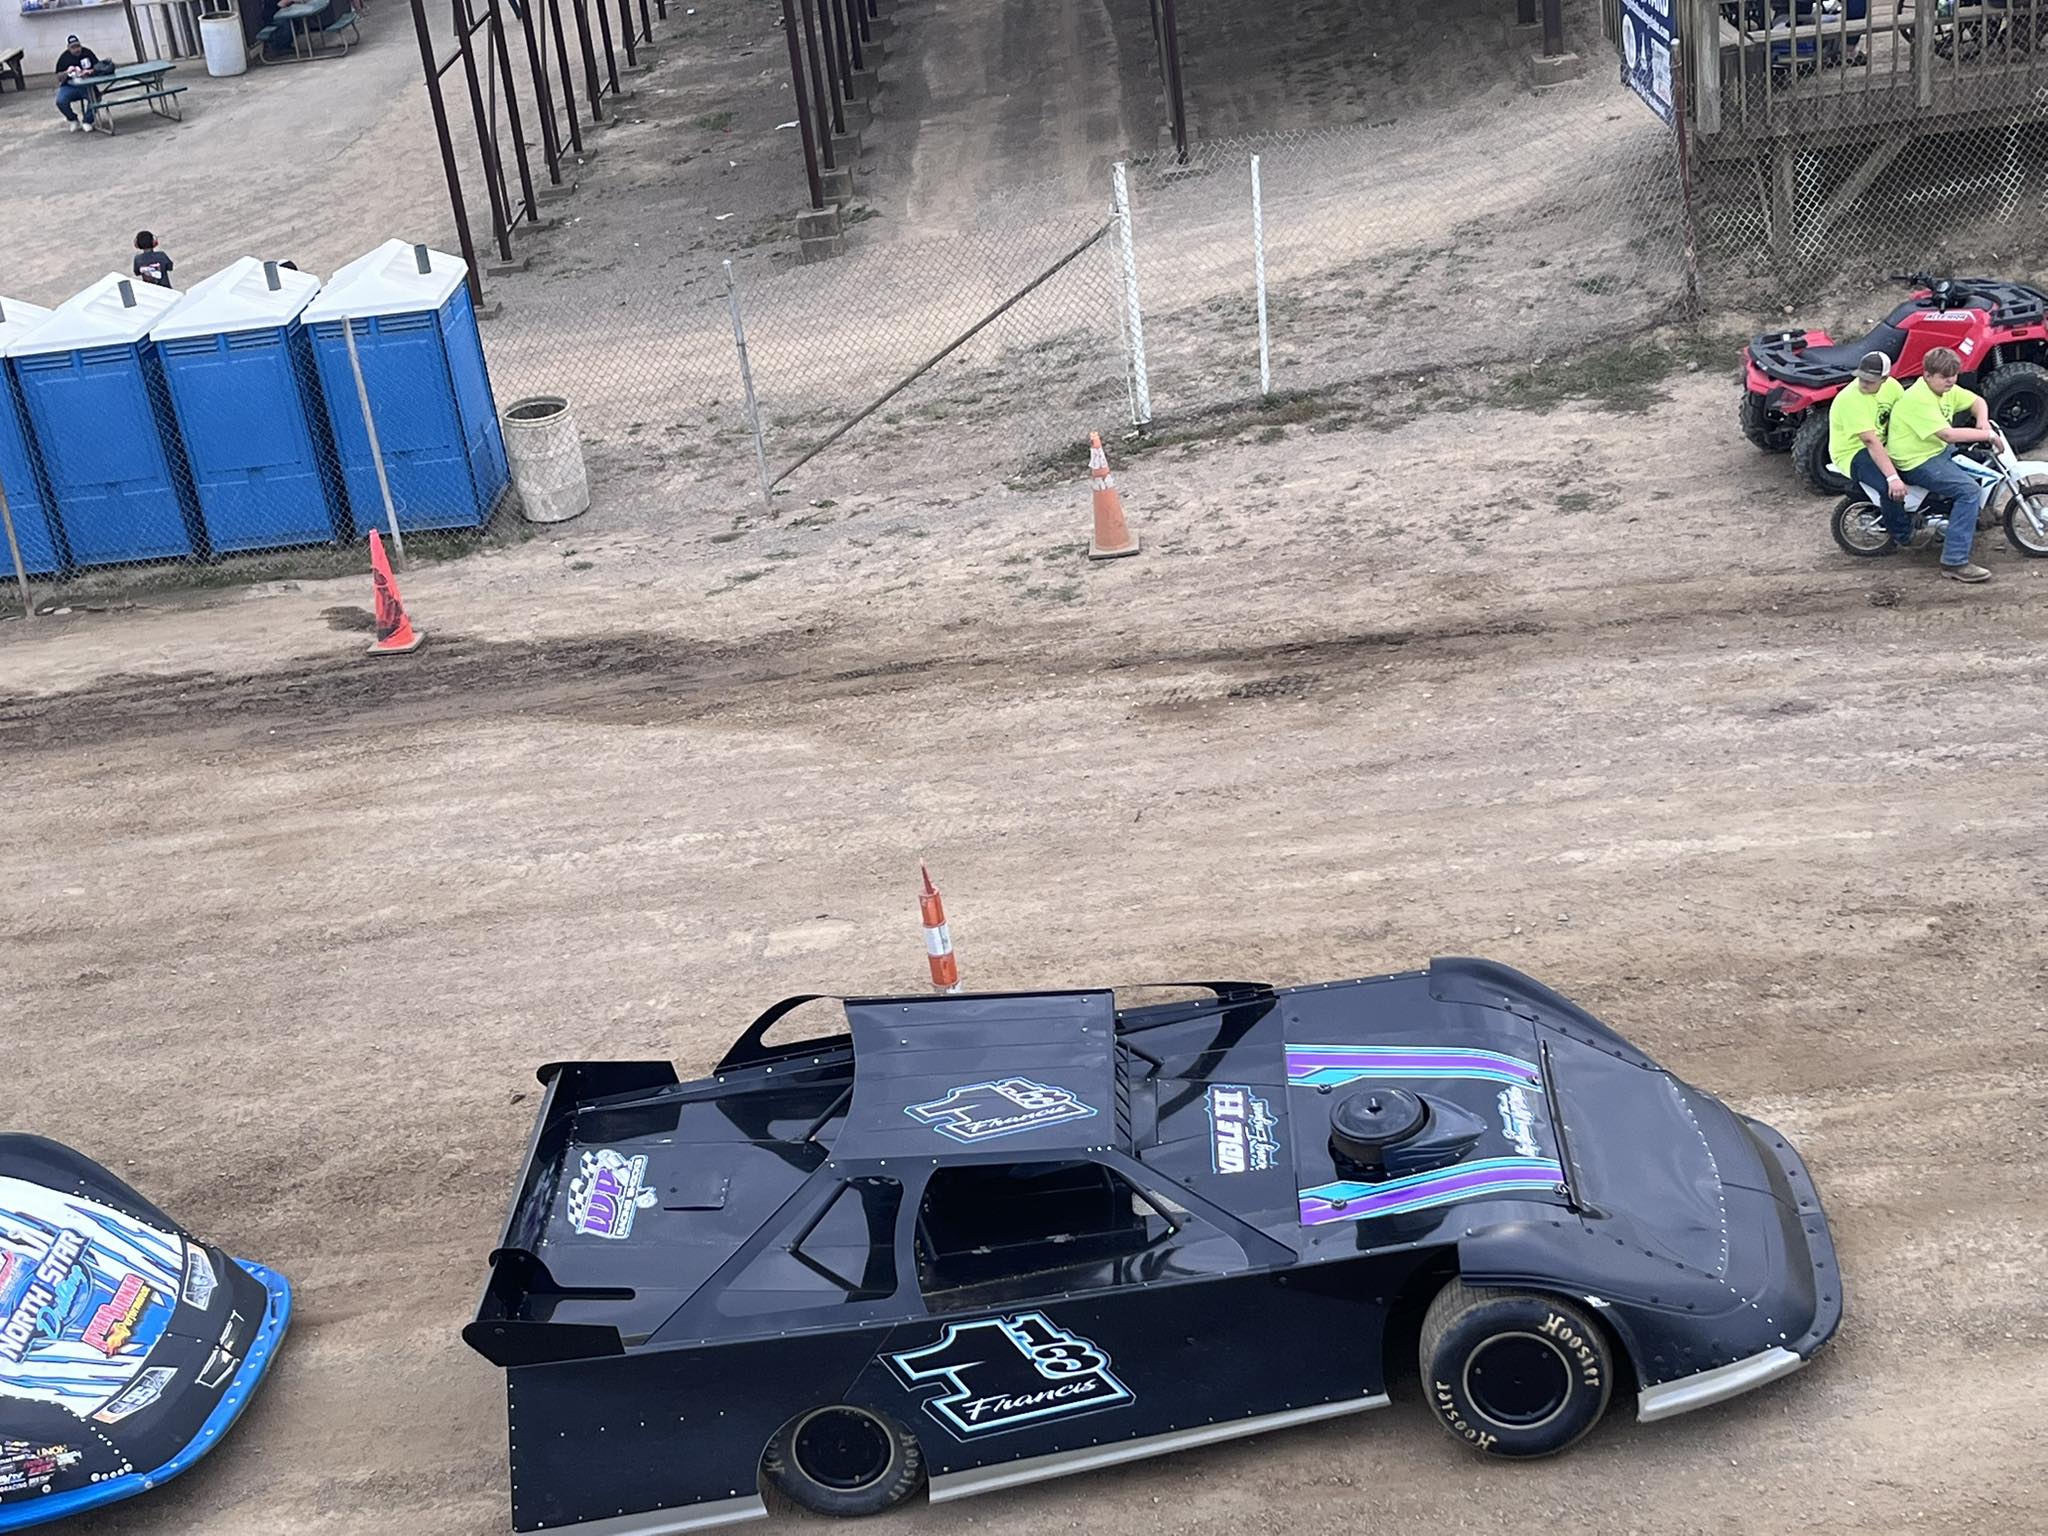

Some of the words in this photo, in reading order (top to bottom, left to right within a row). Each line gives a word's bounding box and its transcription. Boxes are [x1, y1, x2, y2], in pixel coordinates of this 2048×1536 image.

[964, 1105, 1067, 1133] Francis
[2, 1283, 54, 1361] NORTH
[35, 1229, 85, 1288] STAR
[961, 1378, 1098, 1421] Francis
